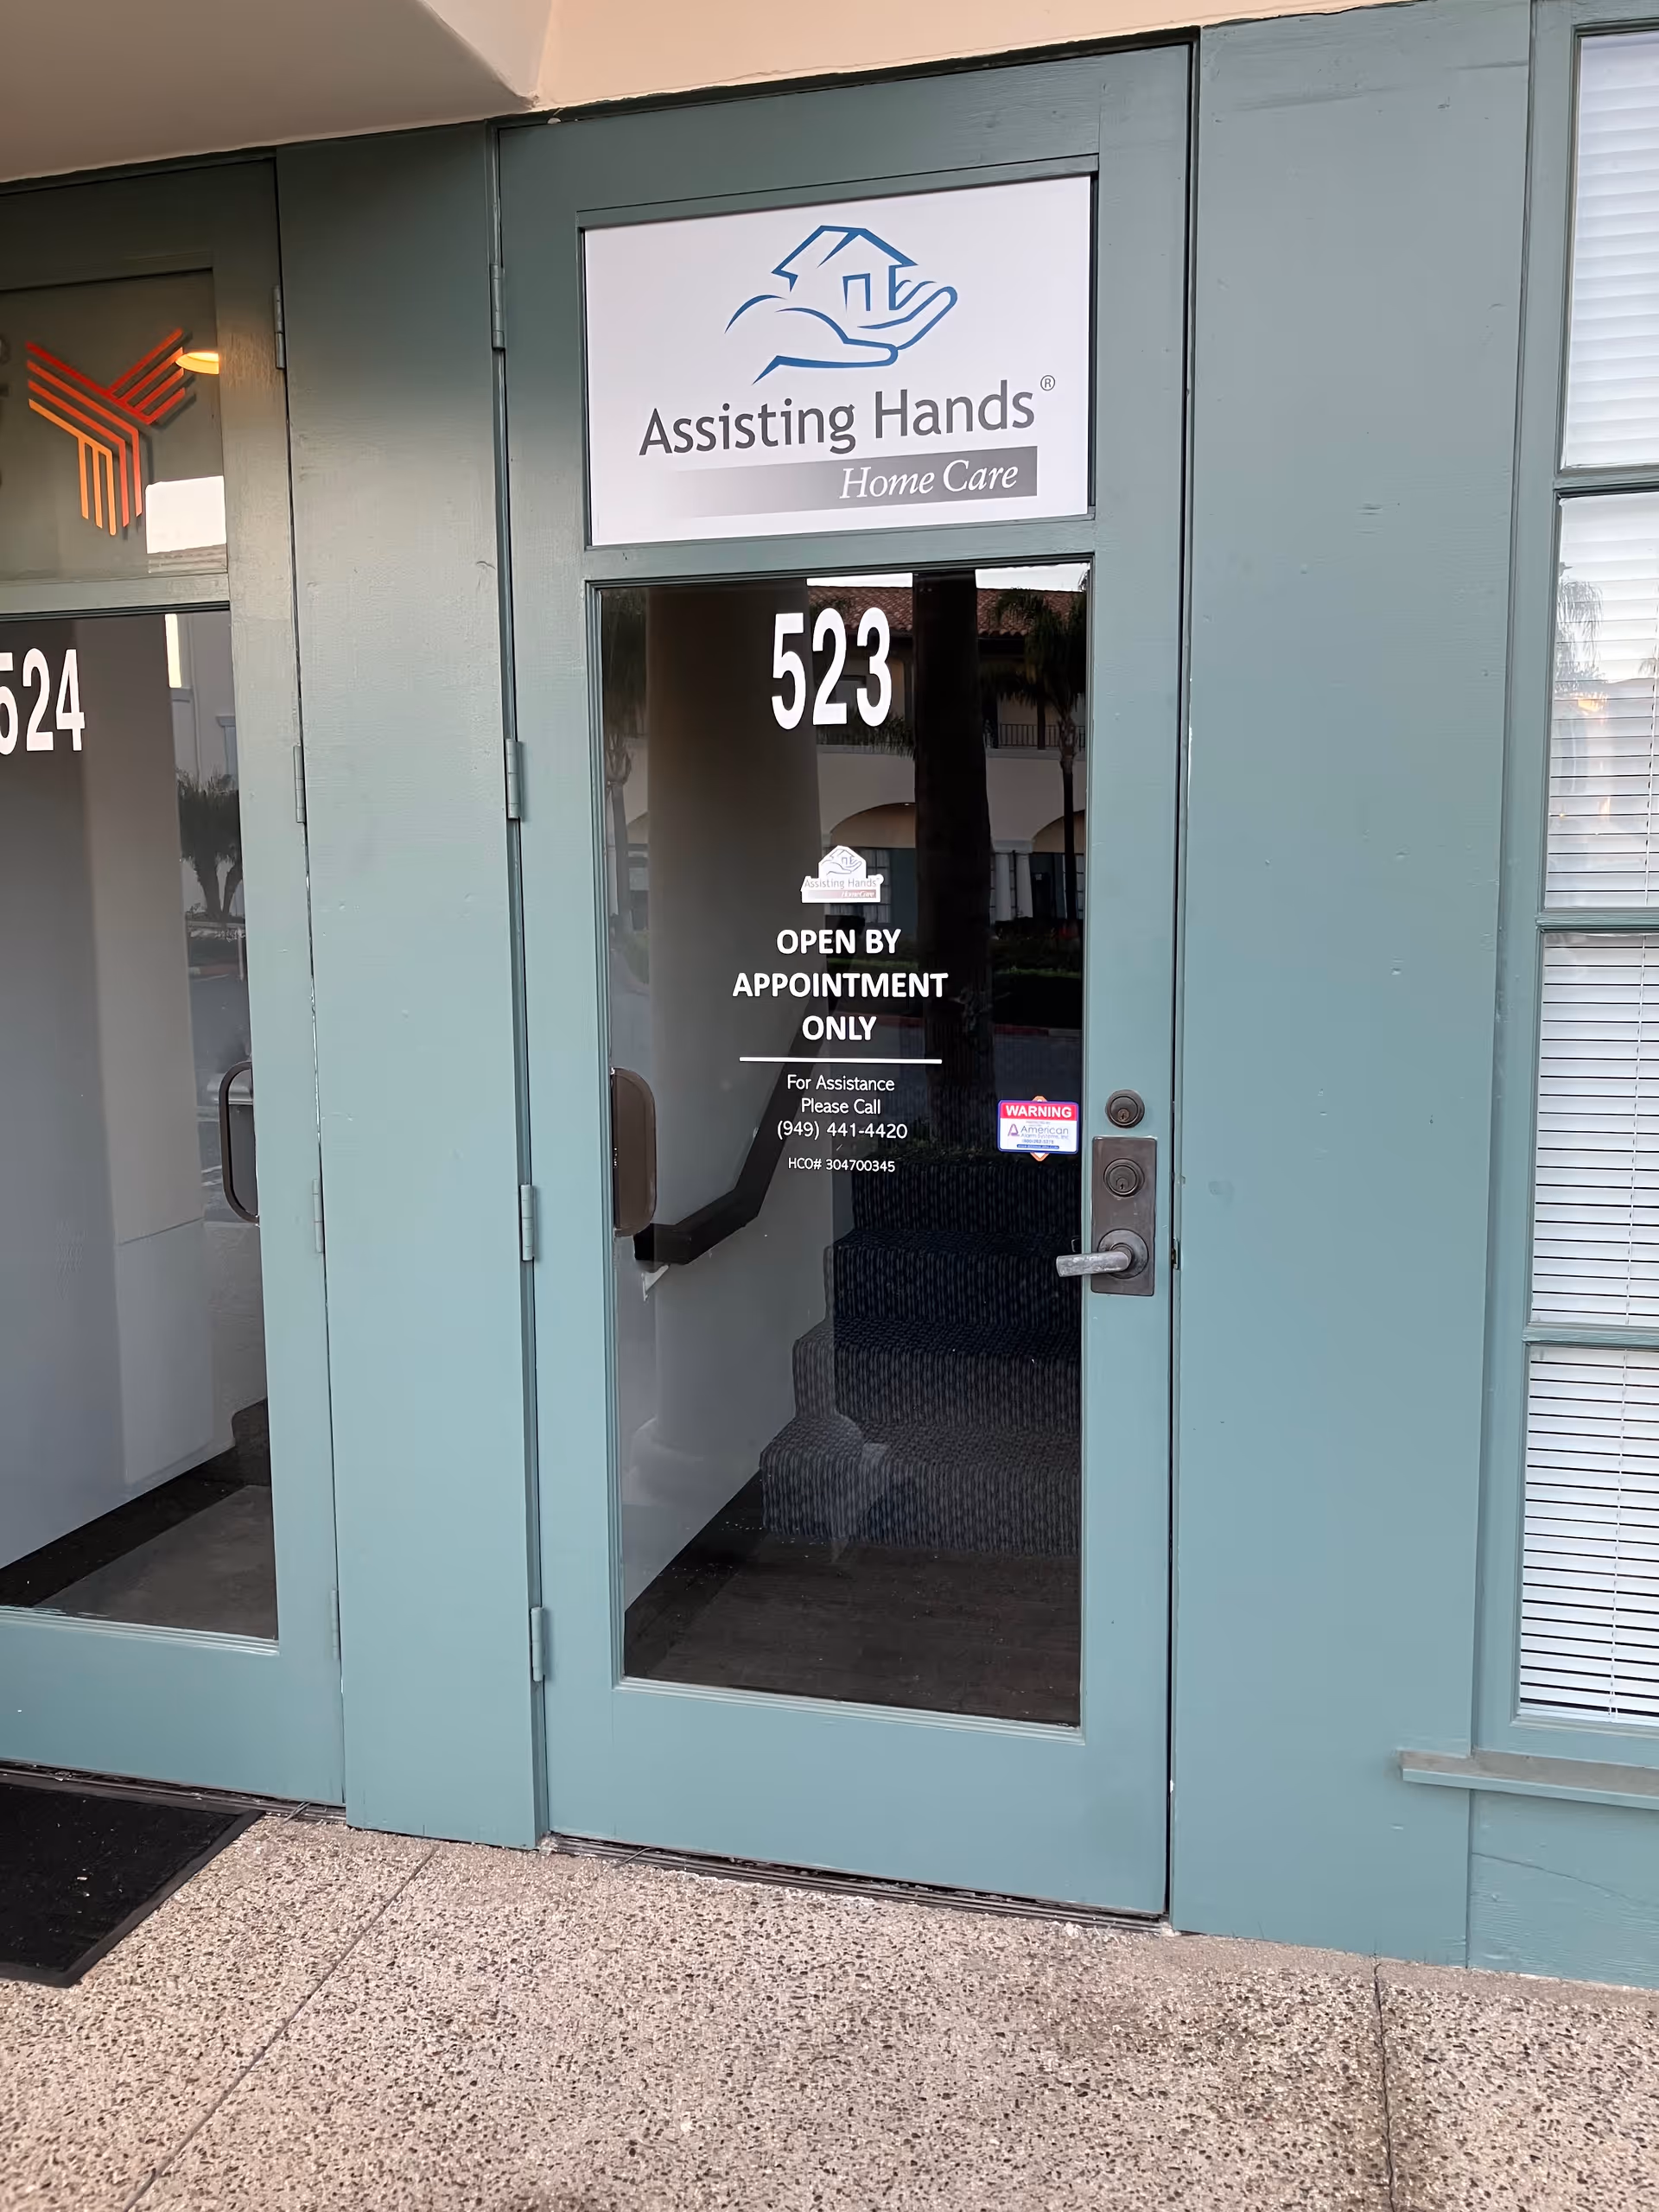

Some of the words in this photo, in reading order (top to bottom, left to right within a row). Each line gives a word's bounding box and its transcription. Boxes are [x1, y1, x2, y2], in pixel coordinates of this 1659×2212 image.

[639, 397, 856, 455] Assisting
[838, 467, 935, 499] Home
[942, 459, 1019, 491] Care
[771, 607, 893, 730] 523
[804, 877, 845, 889] Assisting
[776, 929, 855, 954] OPEN
[866, 928, 901, 954] BY
[732, 972, 949, 998] APPOINTMENT
[802, 1015, 877, 1040] ONLY
[787, 1074, 811, 1090] For
[816, 1075, 895, 1091] Assistance
[801, 1097, 849, 1114] Please
[854, 1098, 881, 1115] Call
[1006, 1104, 1072, 1119] WARNING
[778, 1120, 820, 1140] (949)
[826, 1122, 908, 1139] 441-4420
[1020, 1125, 1069, 1135] American
[788, 1157, 822, 1170] HCO#
[826, 1159, 895, 1173] 304700345
